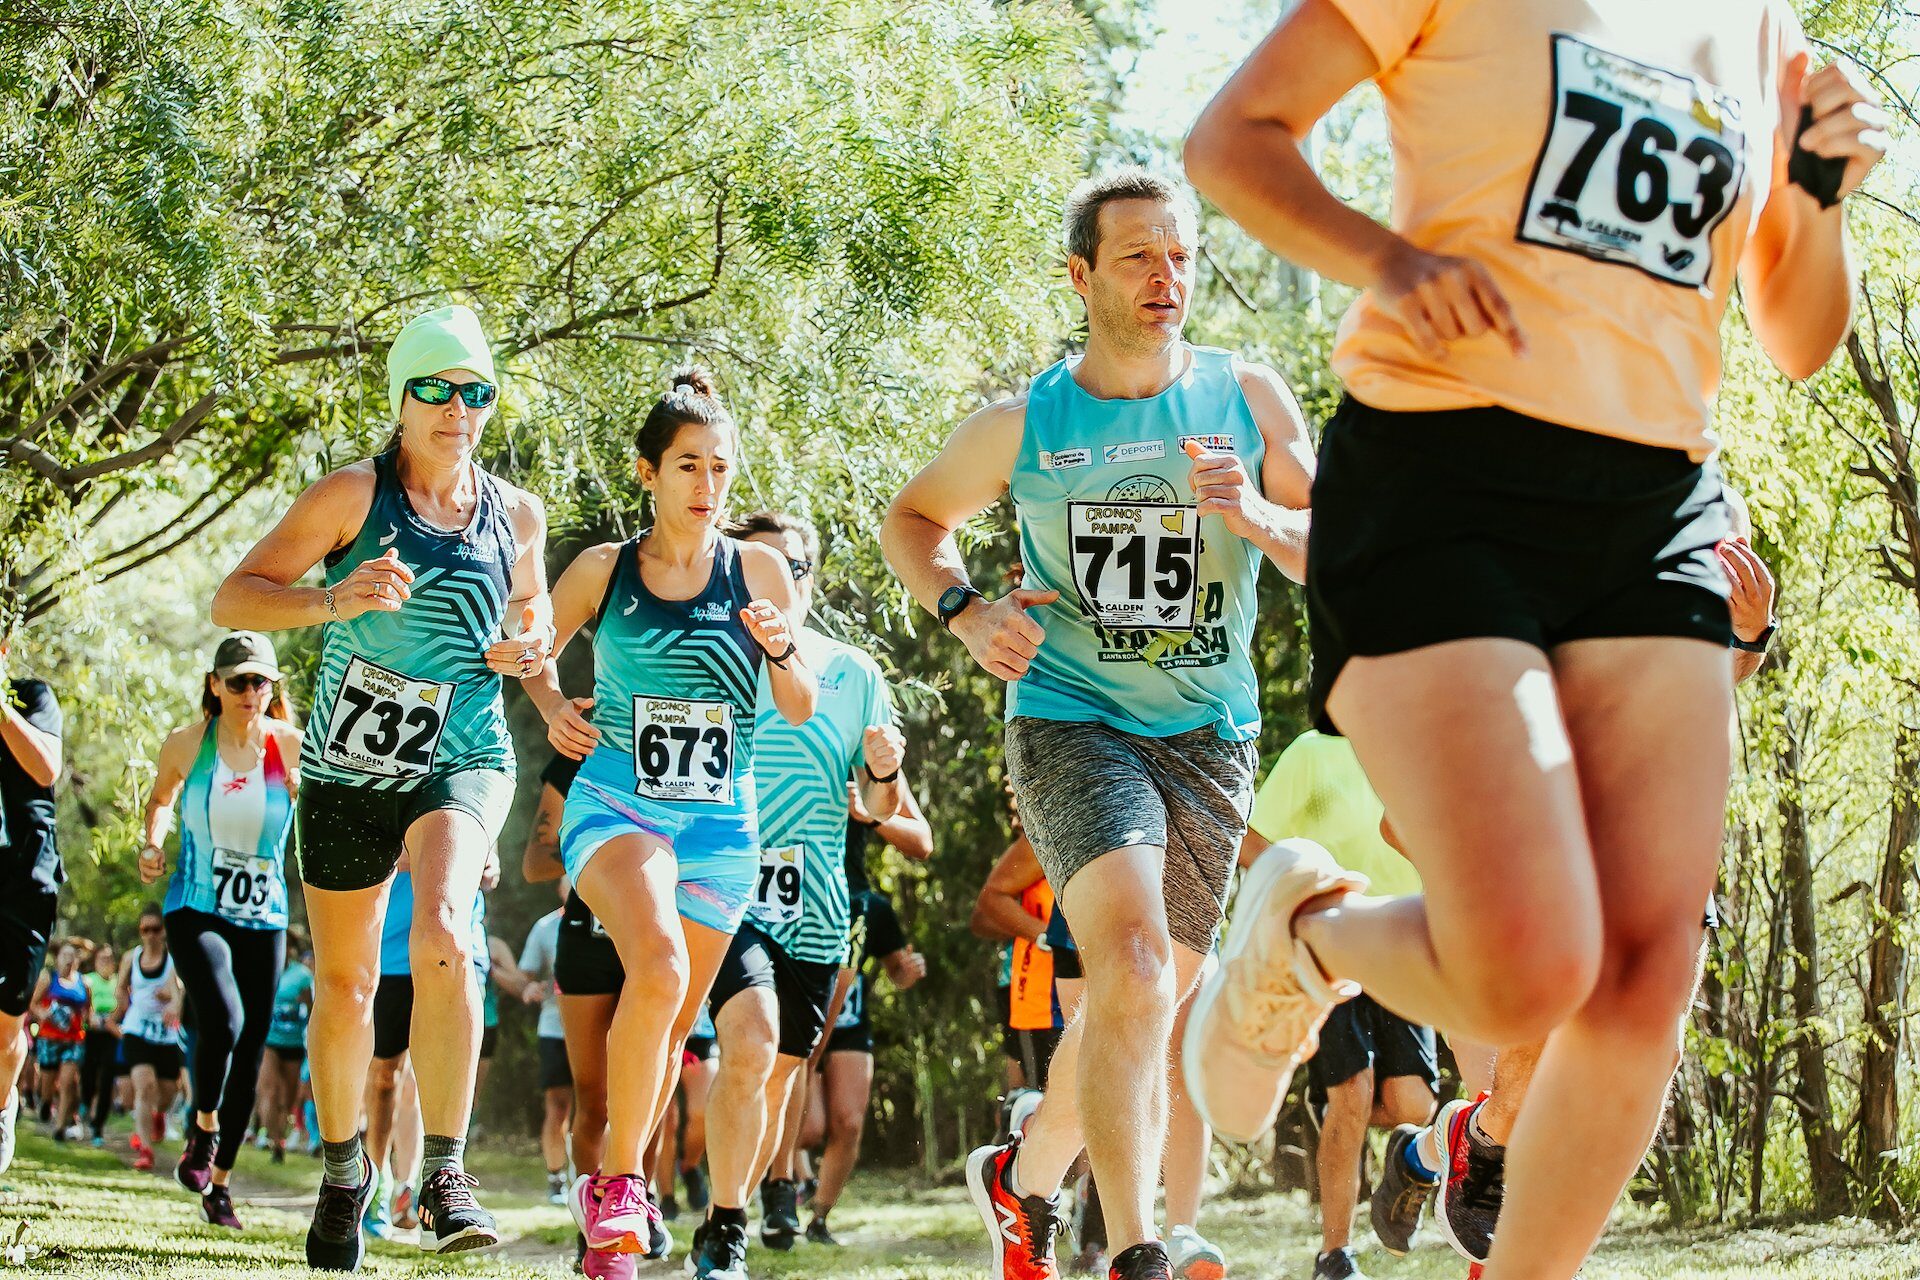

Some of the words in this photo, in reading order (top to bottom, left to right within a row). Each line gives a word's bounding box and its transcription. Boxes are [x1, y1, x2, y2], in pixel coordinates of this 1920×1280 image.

[1554, 90, 1734, 239] 763
[1121, 444, 1164, 456] DEPORTE
[1085, 507, 1142, 523] CRONOS
[1091, 522, 1137, 534] PAMPA
[1075, 535, 1192, 601] 715
[1105, 603, 1144, 611] CALDEN
[1121, 652, 1140, 660] ROSA
[1161, 661, 1172, 669] LA
[1175, 659, 1200, 667] PAMPA
[362, 666, 407, 692] CRONOS
[363, 679, 397, 700] PAMPA
[645, 700, 691, 716] CRONOS
[334, 684, 440, 766] 732
[650, 713, 687, 725] PAMPA
[350, 752, 385, 767] CALDEN
[639, 723, 729, 780] 673
[213, 866, 268, 909] 703
[757, 865, 801, 906] 79
